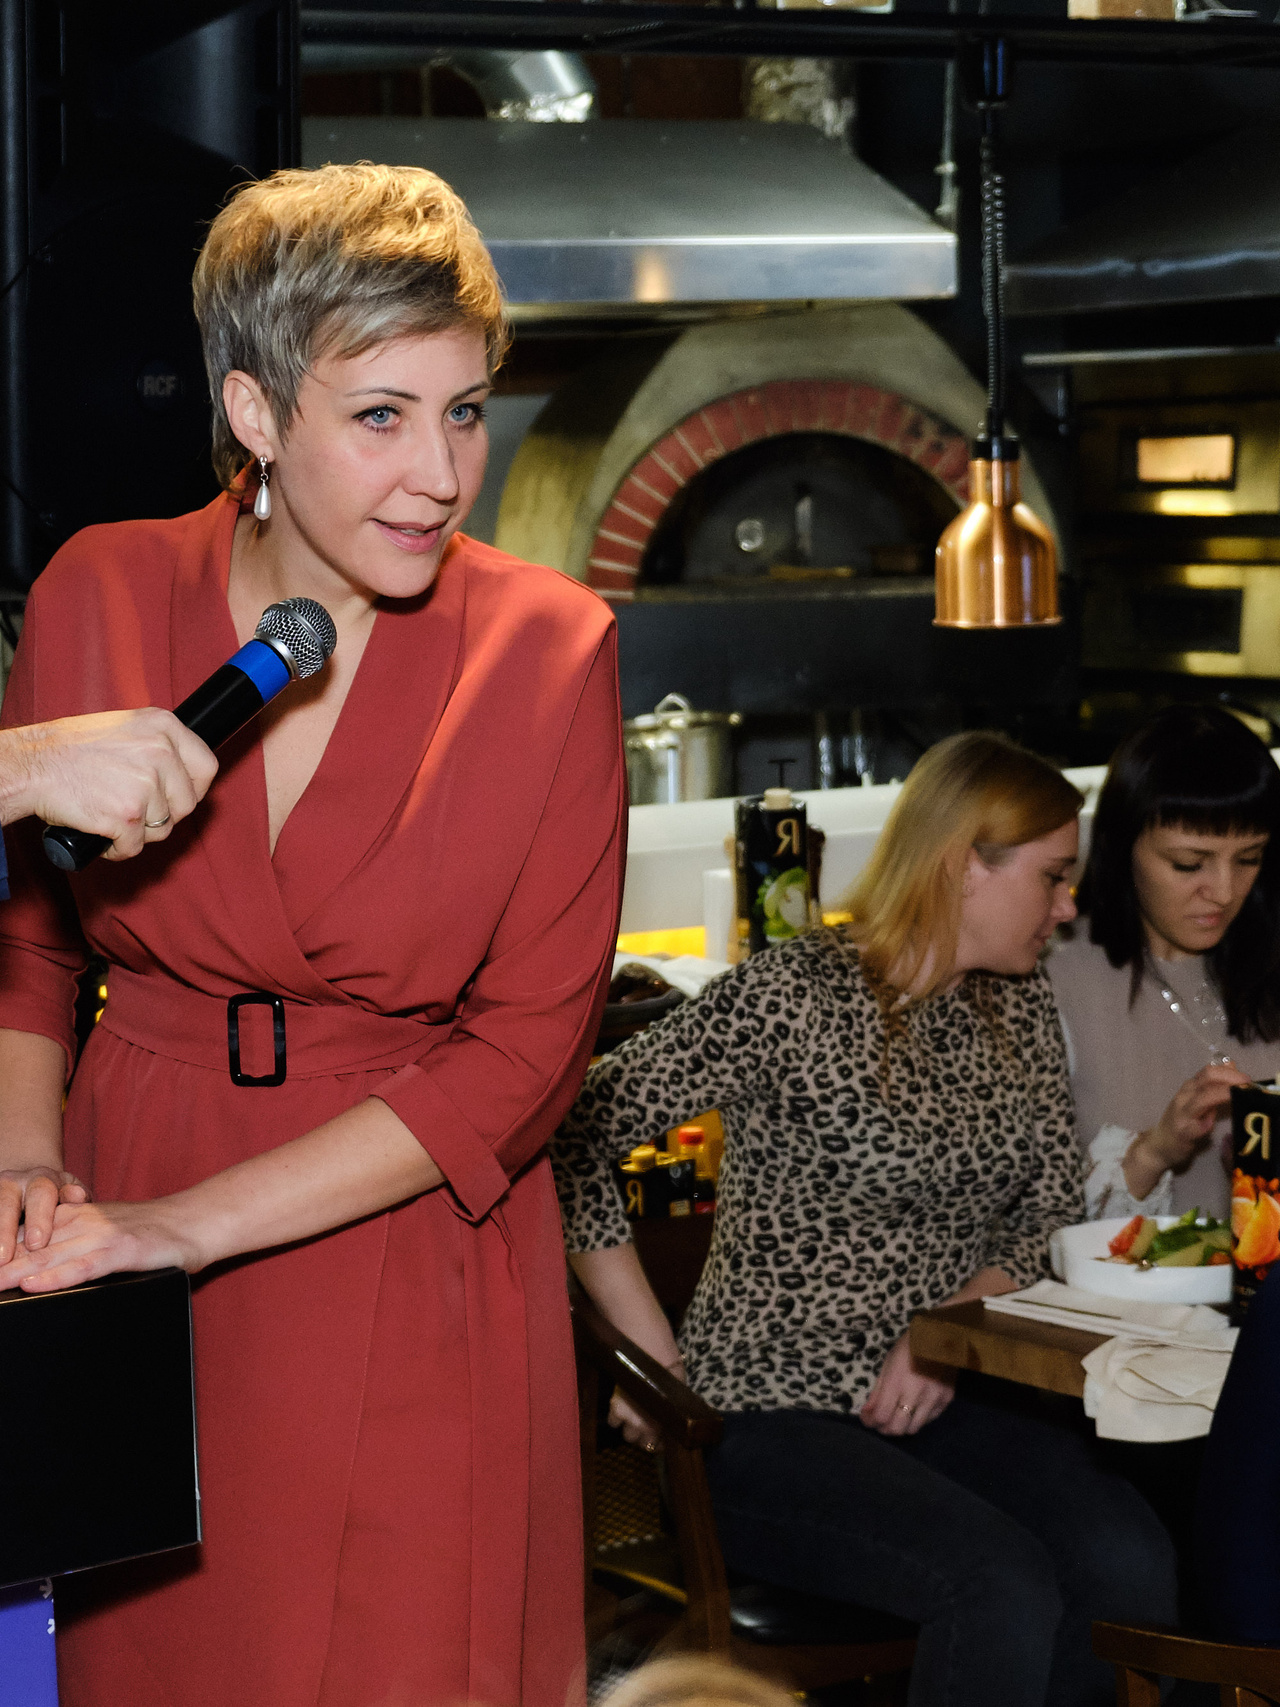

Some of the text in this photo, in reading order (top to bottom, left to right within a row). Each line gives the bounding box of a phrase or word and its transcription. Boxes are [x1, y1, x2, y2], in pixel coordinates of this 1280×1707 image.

[772, 818, 801, 858] Я
[1238, 1111, 1270, 1160] Я
[626, 1179, 644, 1216] Я
